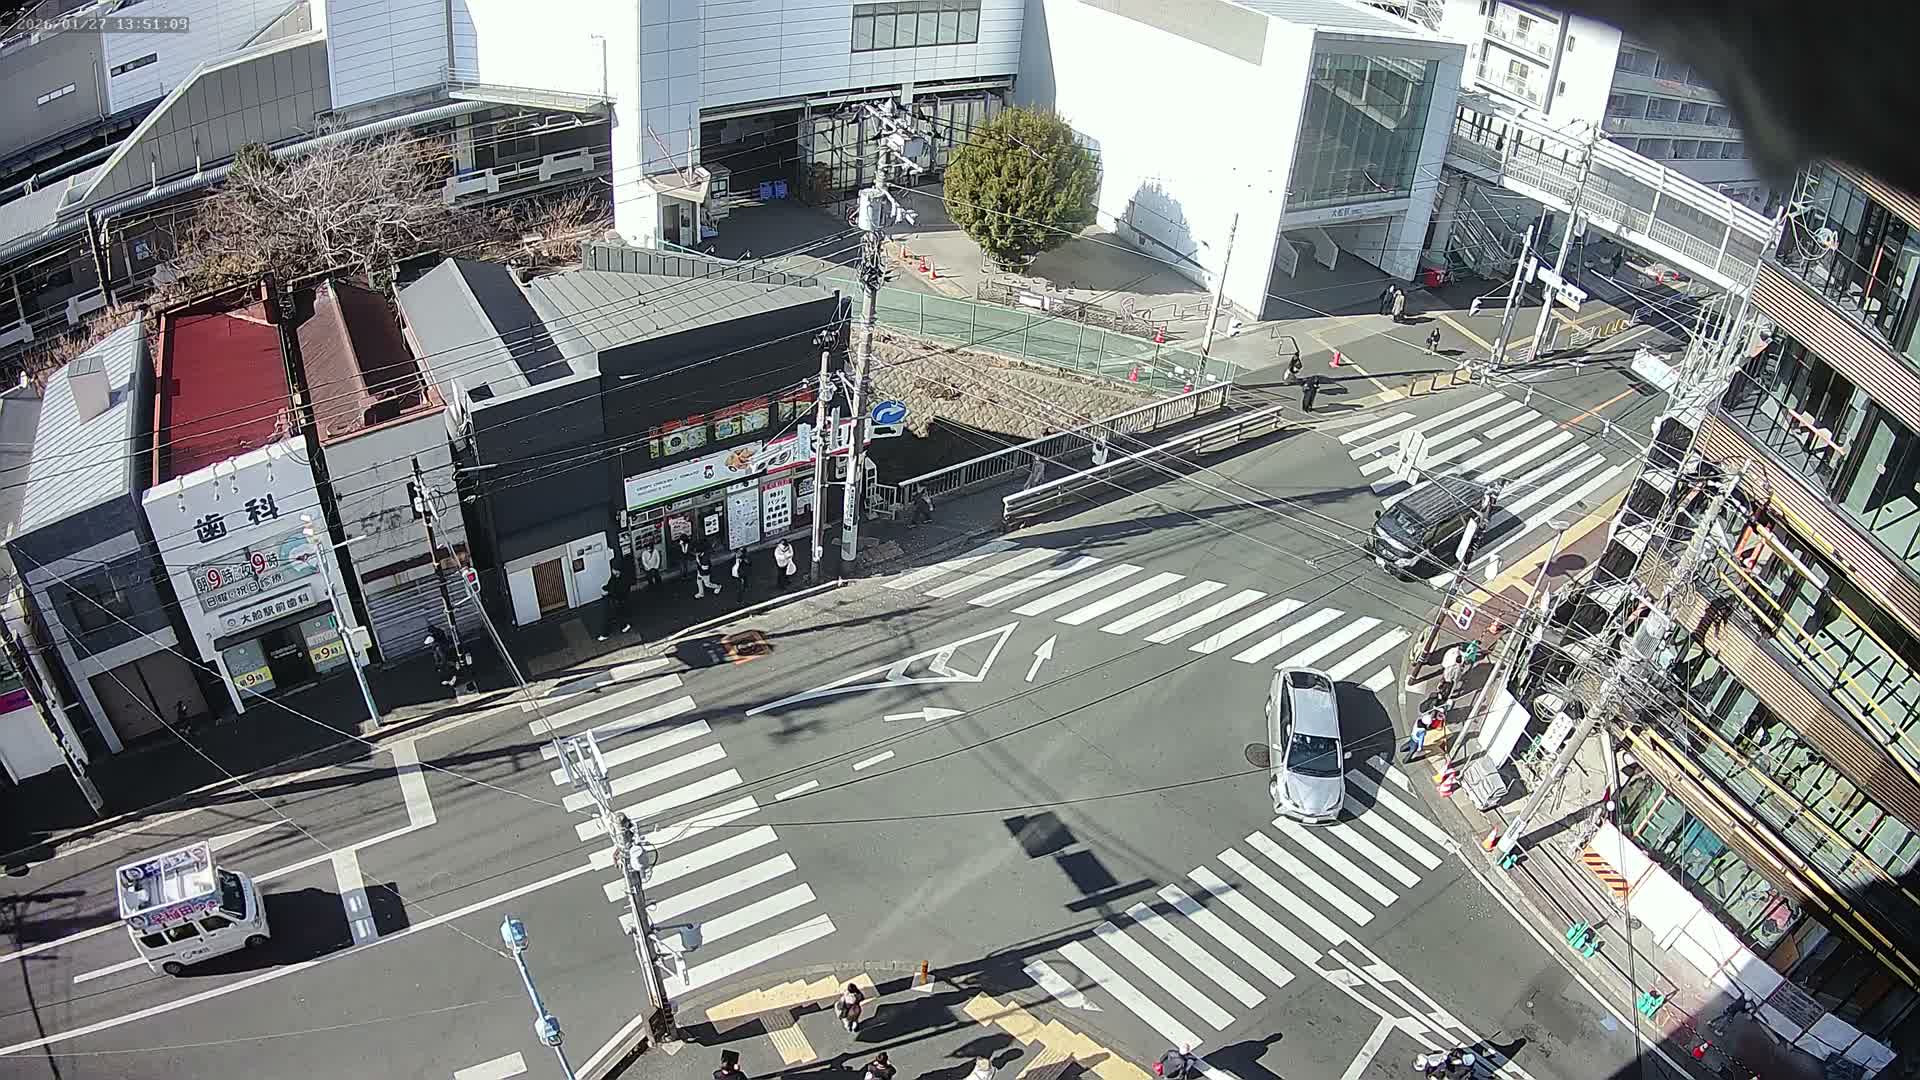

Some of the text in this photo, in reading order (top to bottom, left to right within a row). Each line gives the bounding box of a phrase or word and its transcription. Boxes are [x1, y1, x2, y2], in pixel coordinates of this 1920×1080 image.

[193, 493, 279, 543] 歯科
[241, 593, 309, 624] 大船駅前歯科
